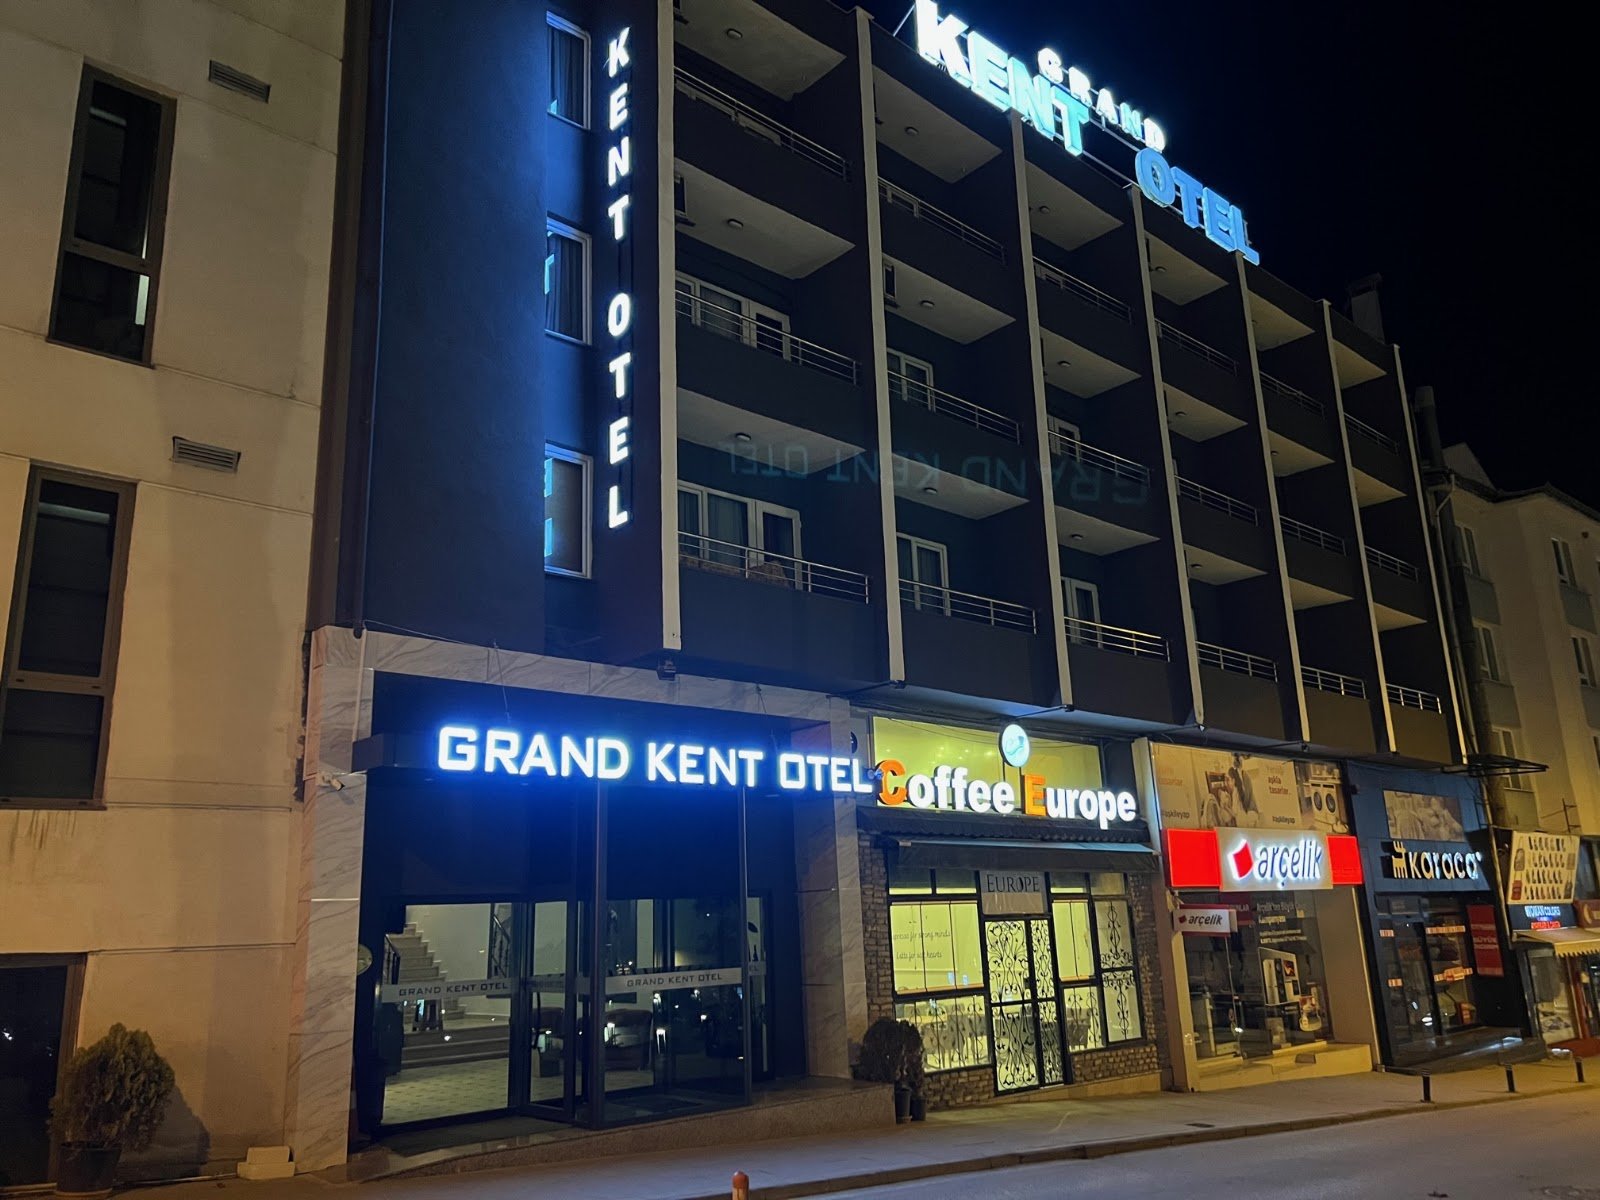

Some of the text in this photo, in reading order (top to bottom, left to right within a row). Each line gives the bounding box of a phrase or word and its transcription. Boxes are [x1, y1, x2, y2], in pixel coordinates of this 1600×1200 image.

[1037, 47, 1167, 153] GRAND
[916, 0, 1260, 266] KENT OTEL
[607, 27, 631, 530] KENT OTEL
[437, 726, 873, 792] GRAND KENT OTEL
[876, 759, 1137, 830] Coffee Europe
[987, 874, 1040, 893] EUROPE
[1257, 840, 1322, 887] arçelik
[1409, 851, 1480, 880] karaca
[1188, 913, 1223, 927] arçelik
[399, 982, 509, 996] GRAND KENT OTEL
[626, 973, 723, 988] GRAND KENT OTEL
